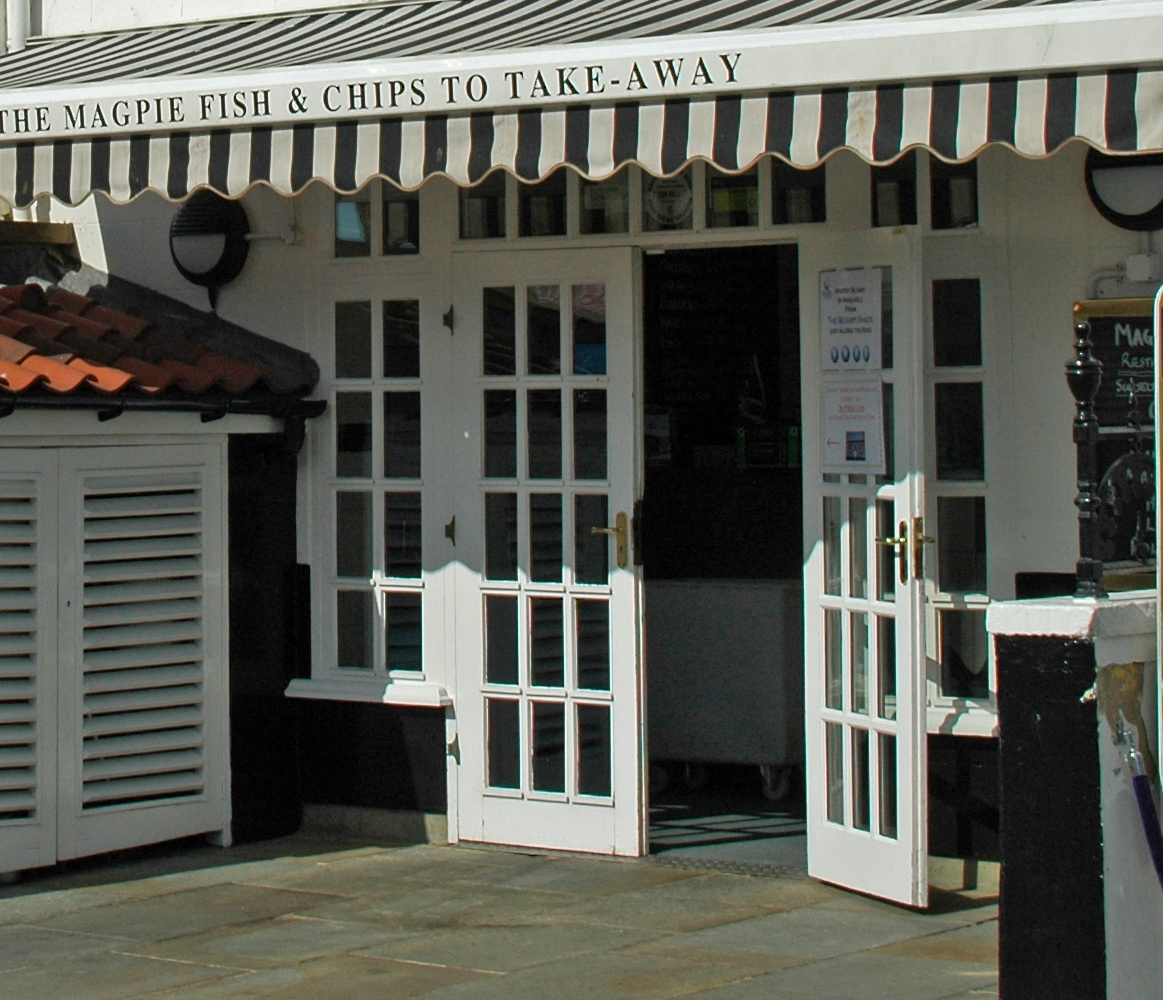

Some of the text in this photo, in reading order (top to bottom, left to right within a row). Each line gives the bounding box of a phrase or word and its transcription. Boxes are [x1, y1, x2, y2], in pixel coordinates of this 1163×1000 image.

[63, 97, 186, 130] MAGPIE
[198, 90, 271, 120] FISH
[288, 87, 309, 113] &
[322, 79, 426, 112] CHIPS
[441, 74, 487, 104] TO
[503, 53, 743, 99] TAKE-AWAY
